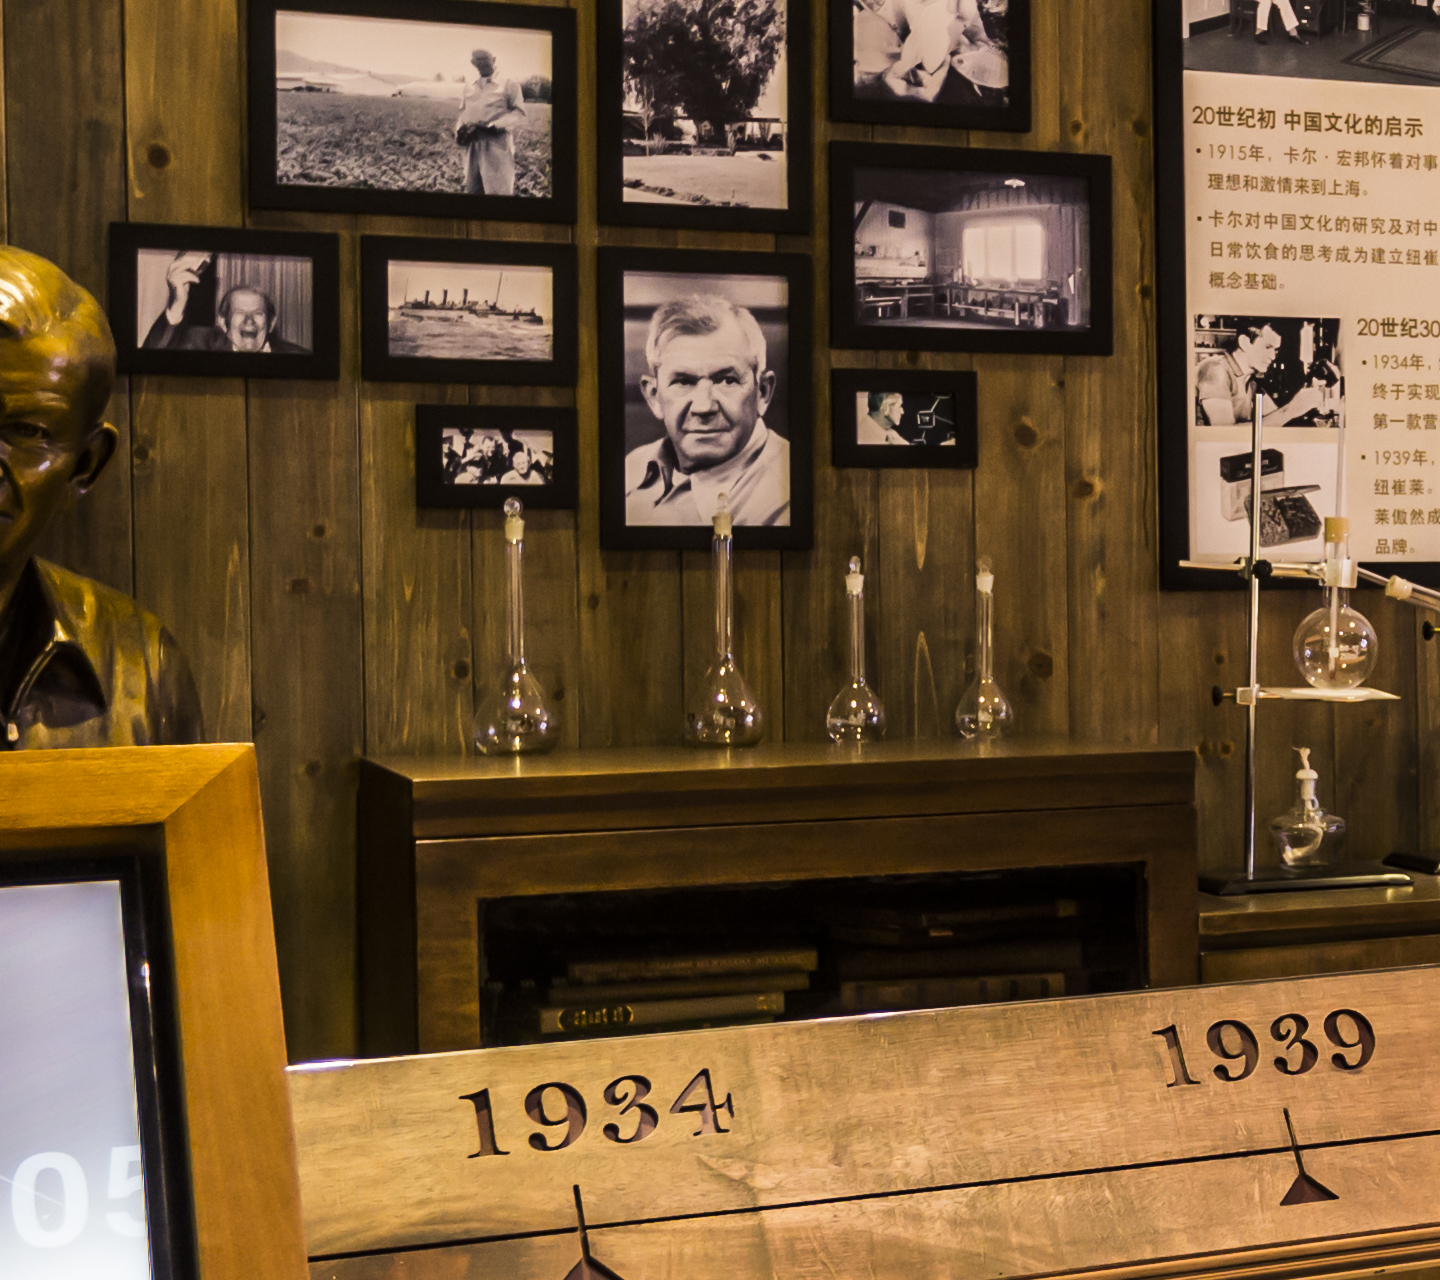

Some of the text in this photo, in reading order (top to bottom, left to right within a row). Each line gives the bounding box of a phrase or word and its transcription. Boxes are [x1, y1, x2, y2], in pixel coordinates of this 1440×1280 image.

[1192, 105, 1424, 138] 20世纪初 中国文化的启示
[1207, 173, 1369, 198] 理想和激情来到上海。
[1209, 270, 1286, 291] 概念基础。
[1375, 538, 1415, 555] 品牌。
[1152, 1007, 1377, 1089] 1939
[460, 1067, 735, 1160] 1934
